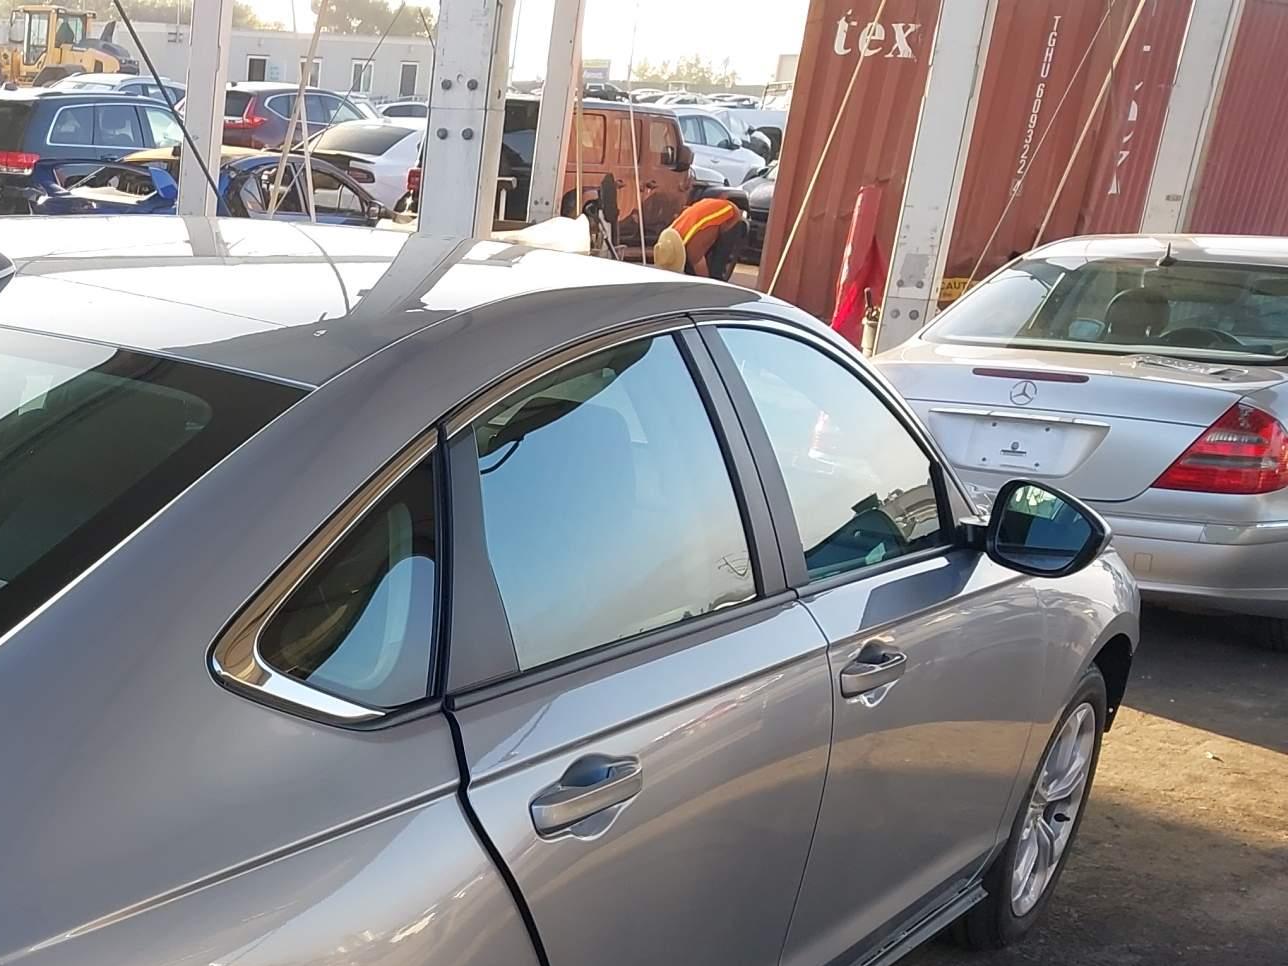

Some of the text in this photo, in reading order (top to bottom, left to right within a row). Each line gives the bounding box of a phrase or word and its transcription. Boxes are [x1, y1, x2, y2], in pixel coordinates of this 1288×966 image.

[834, 9, 921, 58] tex
[1040, 15, 1061, 78] TGHU
[1017, 83, 1045, 174] 609322
[941, 280, 968, 290] CAUT
